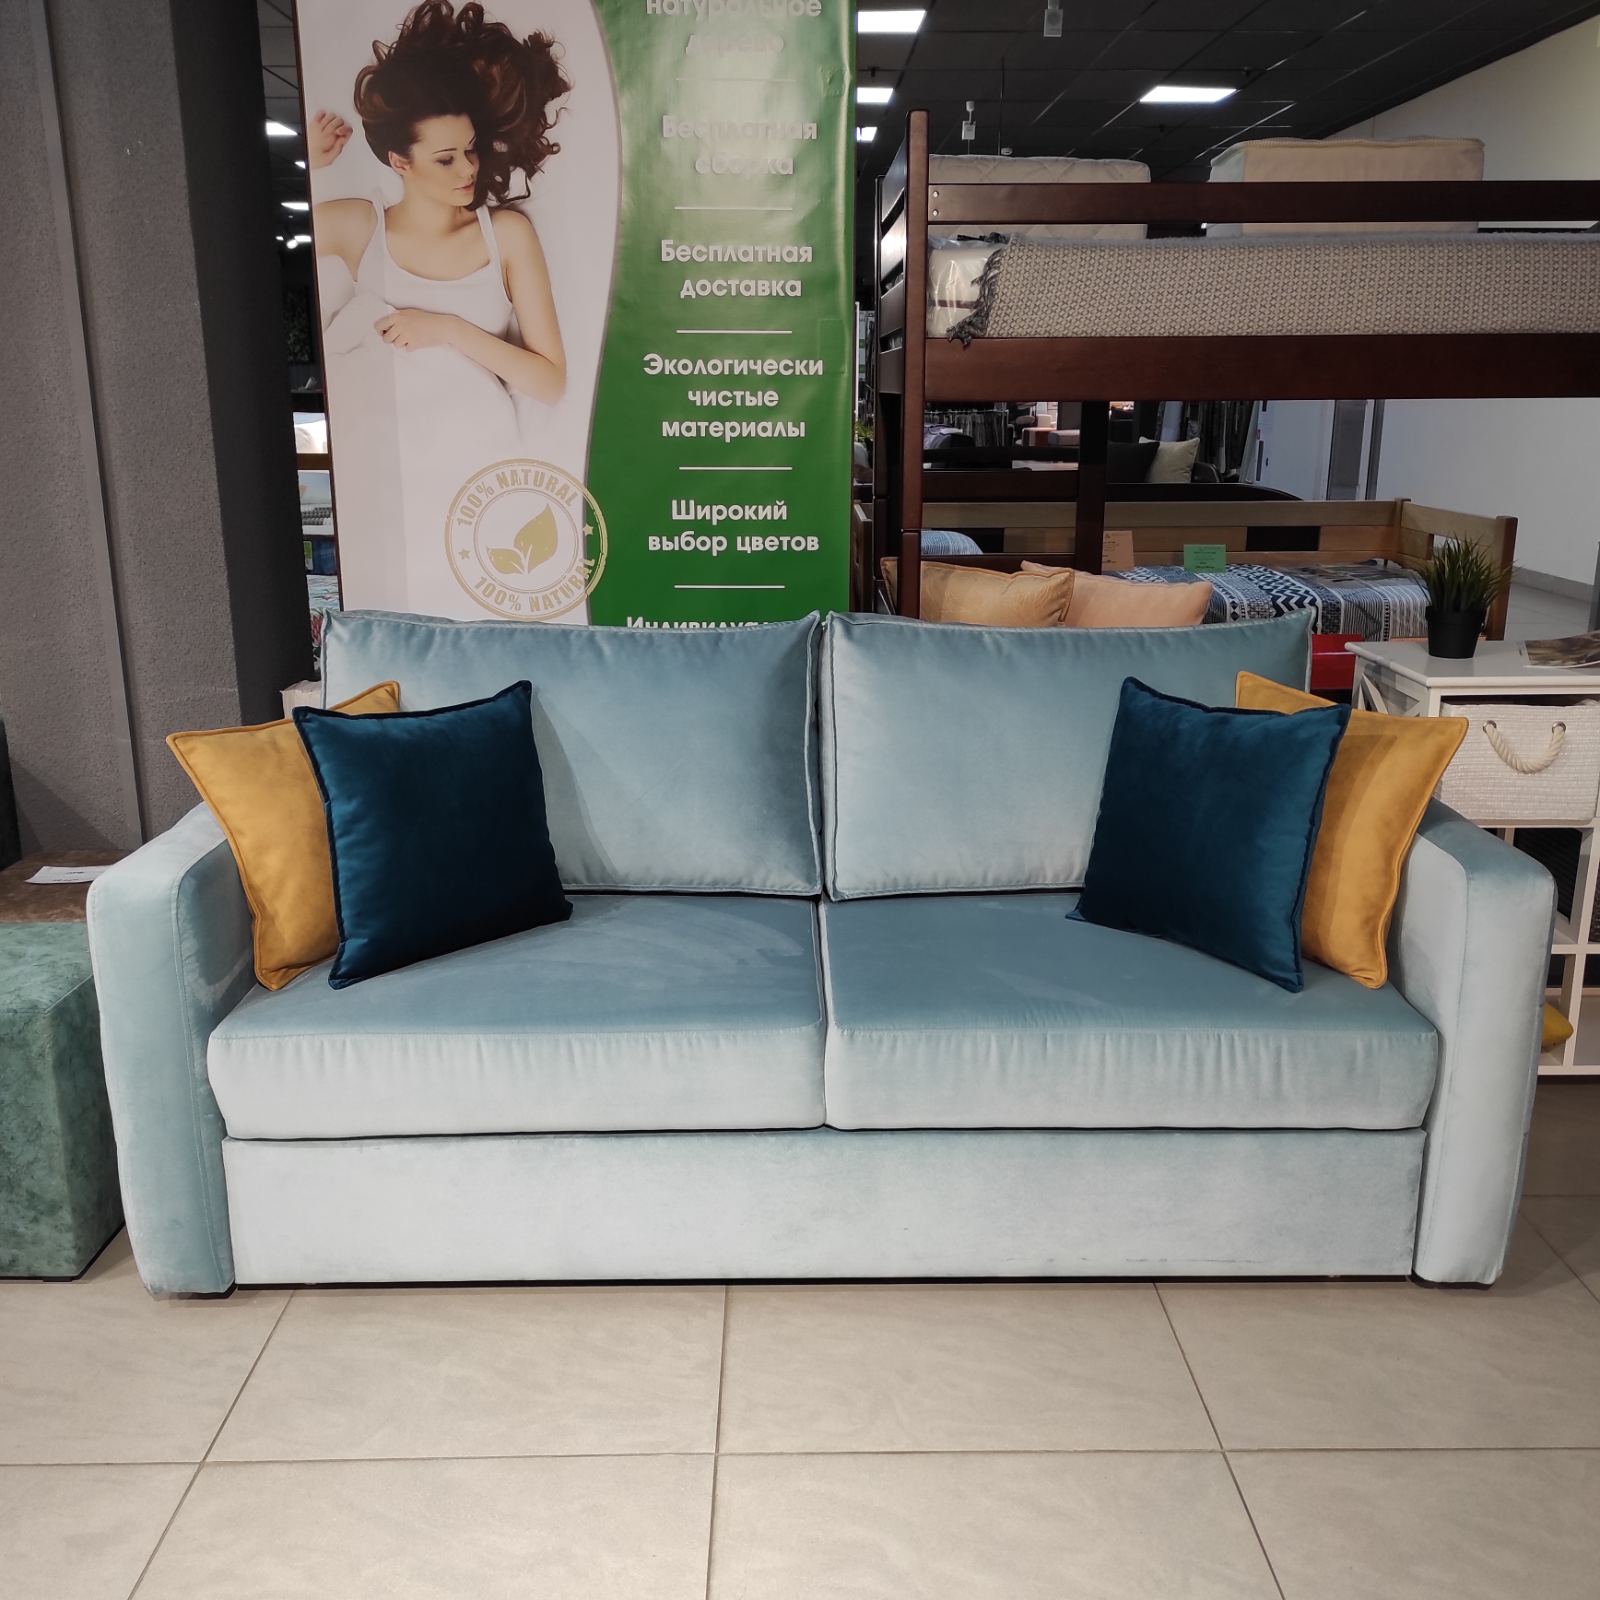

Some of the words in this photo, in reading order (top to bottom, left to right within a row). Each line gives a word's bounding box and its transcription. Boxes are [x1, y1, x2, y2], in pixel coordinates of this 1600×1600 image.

[662, 115, 817, 140] Бесплатная
[695, 152, 794, 179] сборка
[661, 240, 813, 263] Бесплатная
[680, 279, 802, 299] доставка
[643, 353, 824, 376] Экологически
[687, 389, 780, 407] чистые
[662, 420, 806, 443] материалы
[457, 481, 495, 526] 100%
[495, 468, 578, 507] NATURAL
[671, 499, 788, 526] Широкий
[648, 531, 727, 556] выбор
[736, 535, 820, 554] цветов
[474, 576, 522, 611] 100%
[529, 558, 596, 612] NATURAL
